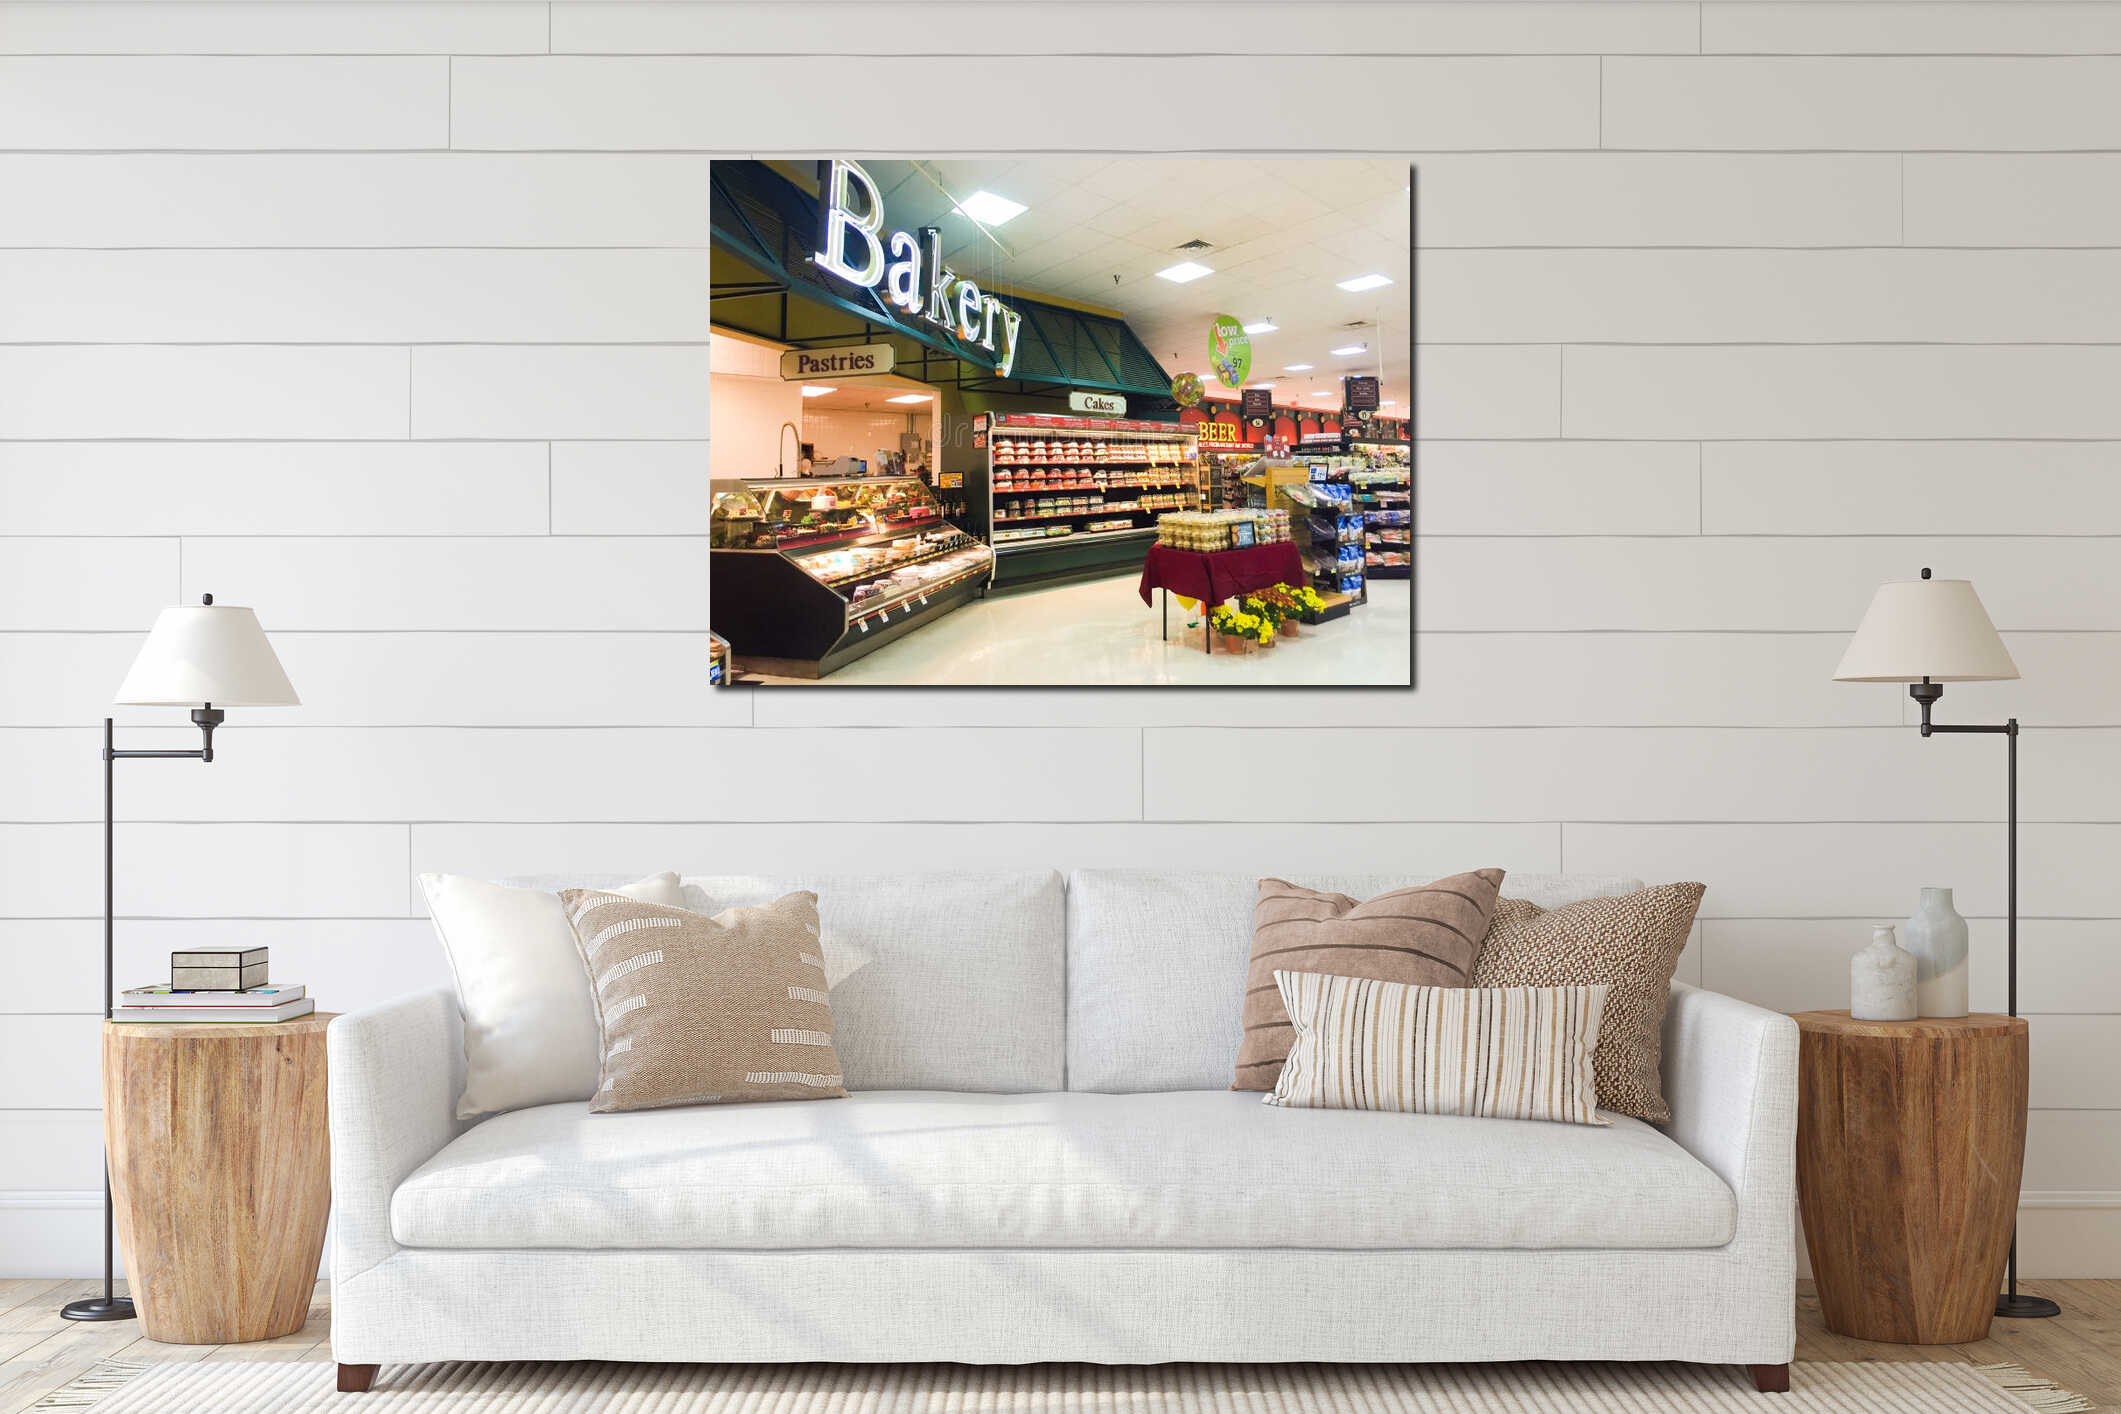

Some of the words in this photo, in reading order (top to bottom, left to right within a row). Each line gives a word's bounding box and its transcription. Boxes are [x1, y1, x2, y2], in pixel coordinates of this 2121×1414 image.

[814, 160, 1021, 377] Bakery
[797, 352, 875, 374] Pastries
[1083, 396, 1115, 410] Cakes
[1198, 422, 1237, 442] BEER
